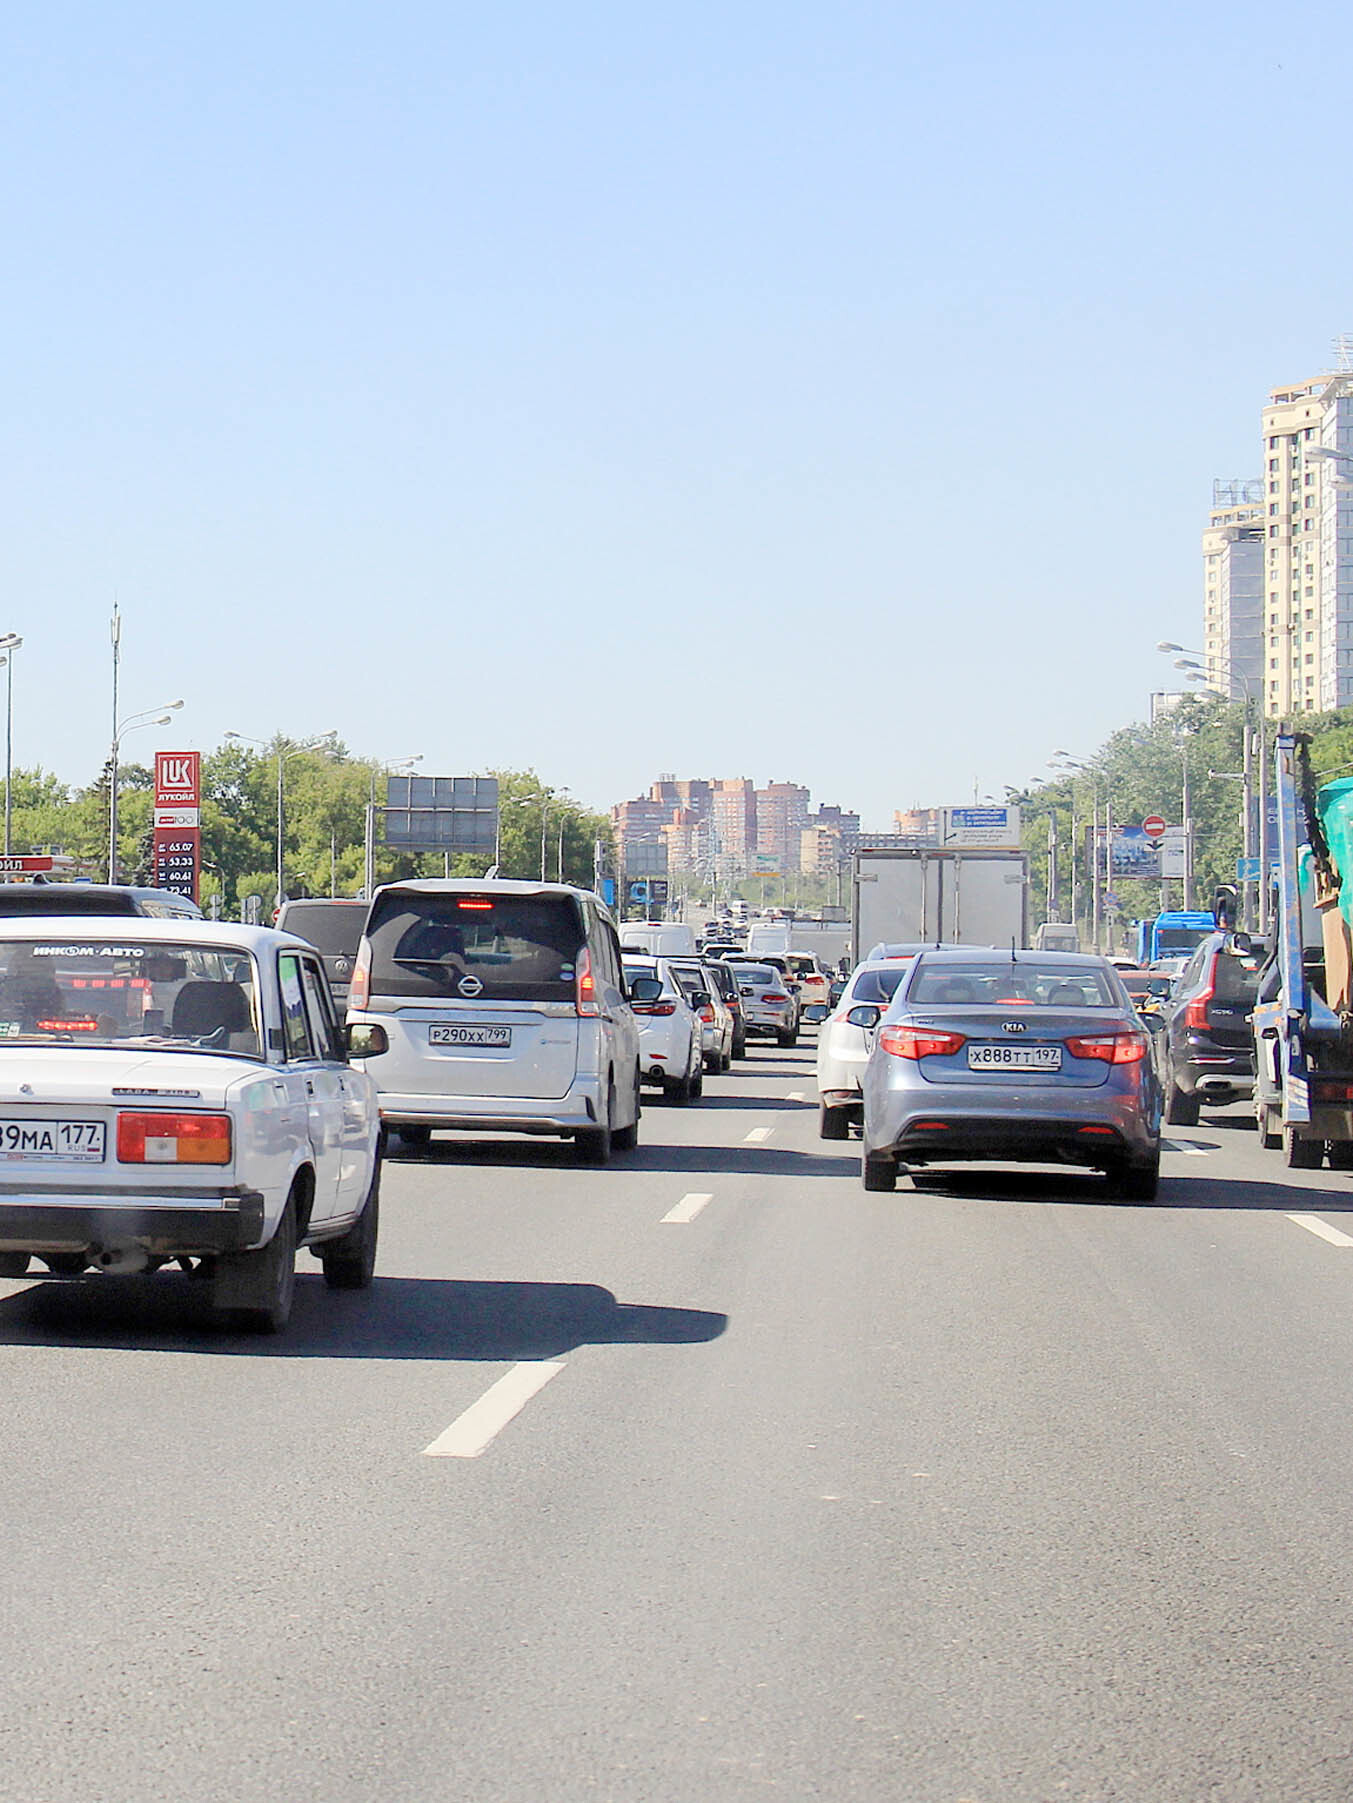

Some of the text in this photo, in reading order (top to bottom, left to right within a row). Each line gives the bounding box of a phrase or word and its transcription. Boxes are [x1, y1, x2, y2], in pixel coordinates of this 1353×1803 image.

[158, 792, 195, 801] ЛУКОЙЛ
[1006, 1022, 1025, 1031] KIA
[487, 1029, 507, 1039] 799
[973, 1048, 1058, 1063] Х888ТТ 197
[60, 1125, 98, 1145] 177
